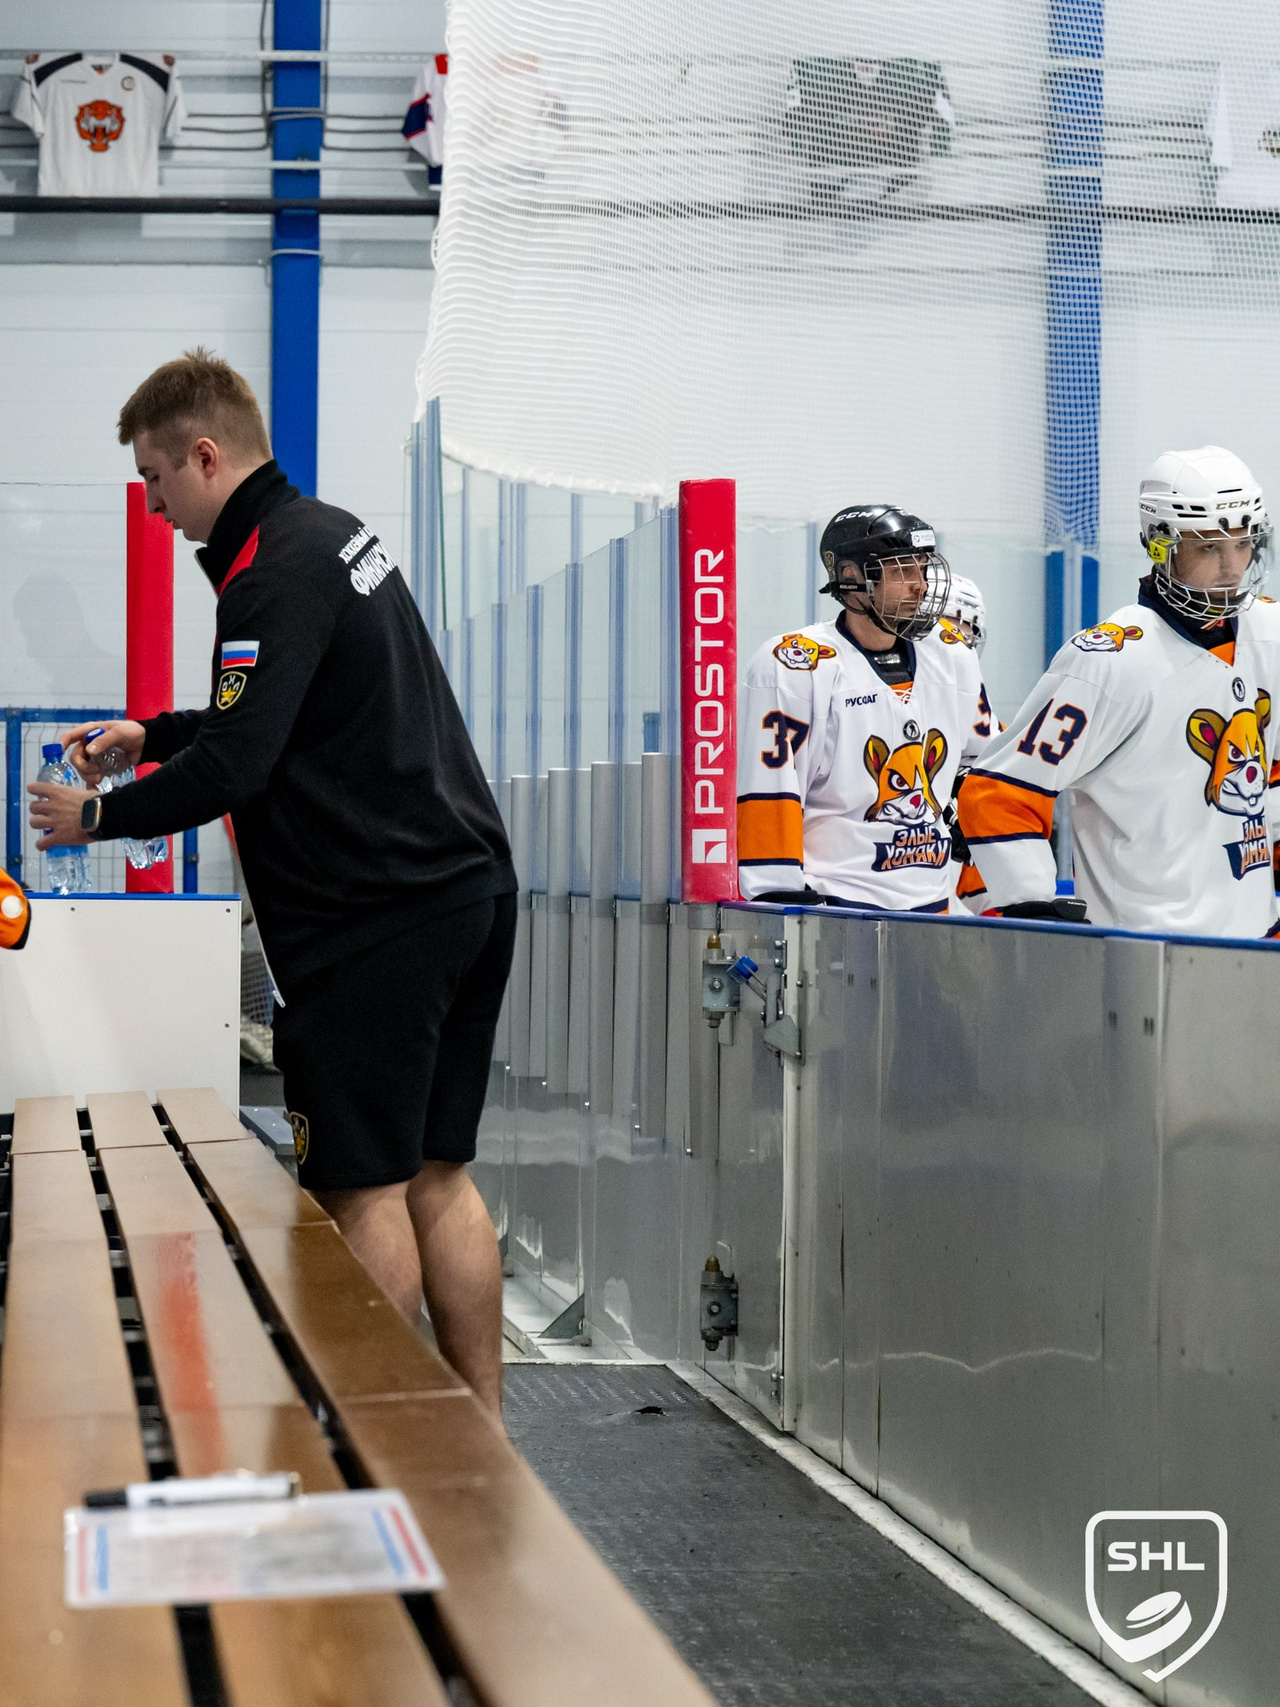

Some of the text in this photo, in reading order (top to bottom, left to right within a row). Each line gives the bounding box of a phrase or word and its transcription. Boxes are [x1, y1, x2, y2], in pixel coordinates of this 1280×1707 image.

[1140, 503, 1157, 515] CCM
[1216, 500, 1251, 511] CCM
[694, 548, 725, 815] PROSTOR
[761, 709, 810, 769] 37
[1016, 697, 1088, 766] 13
[895, 825, 937, 847] ЗЛЫЕ
[881, 840, 948, 871] ХОМЯКИ
